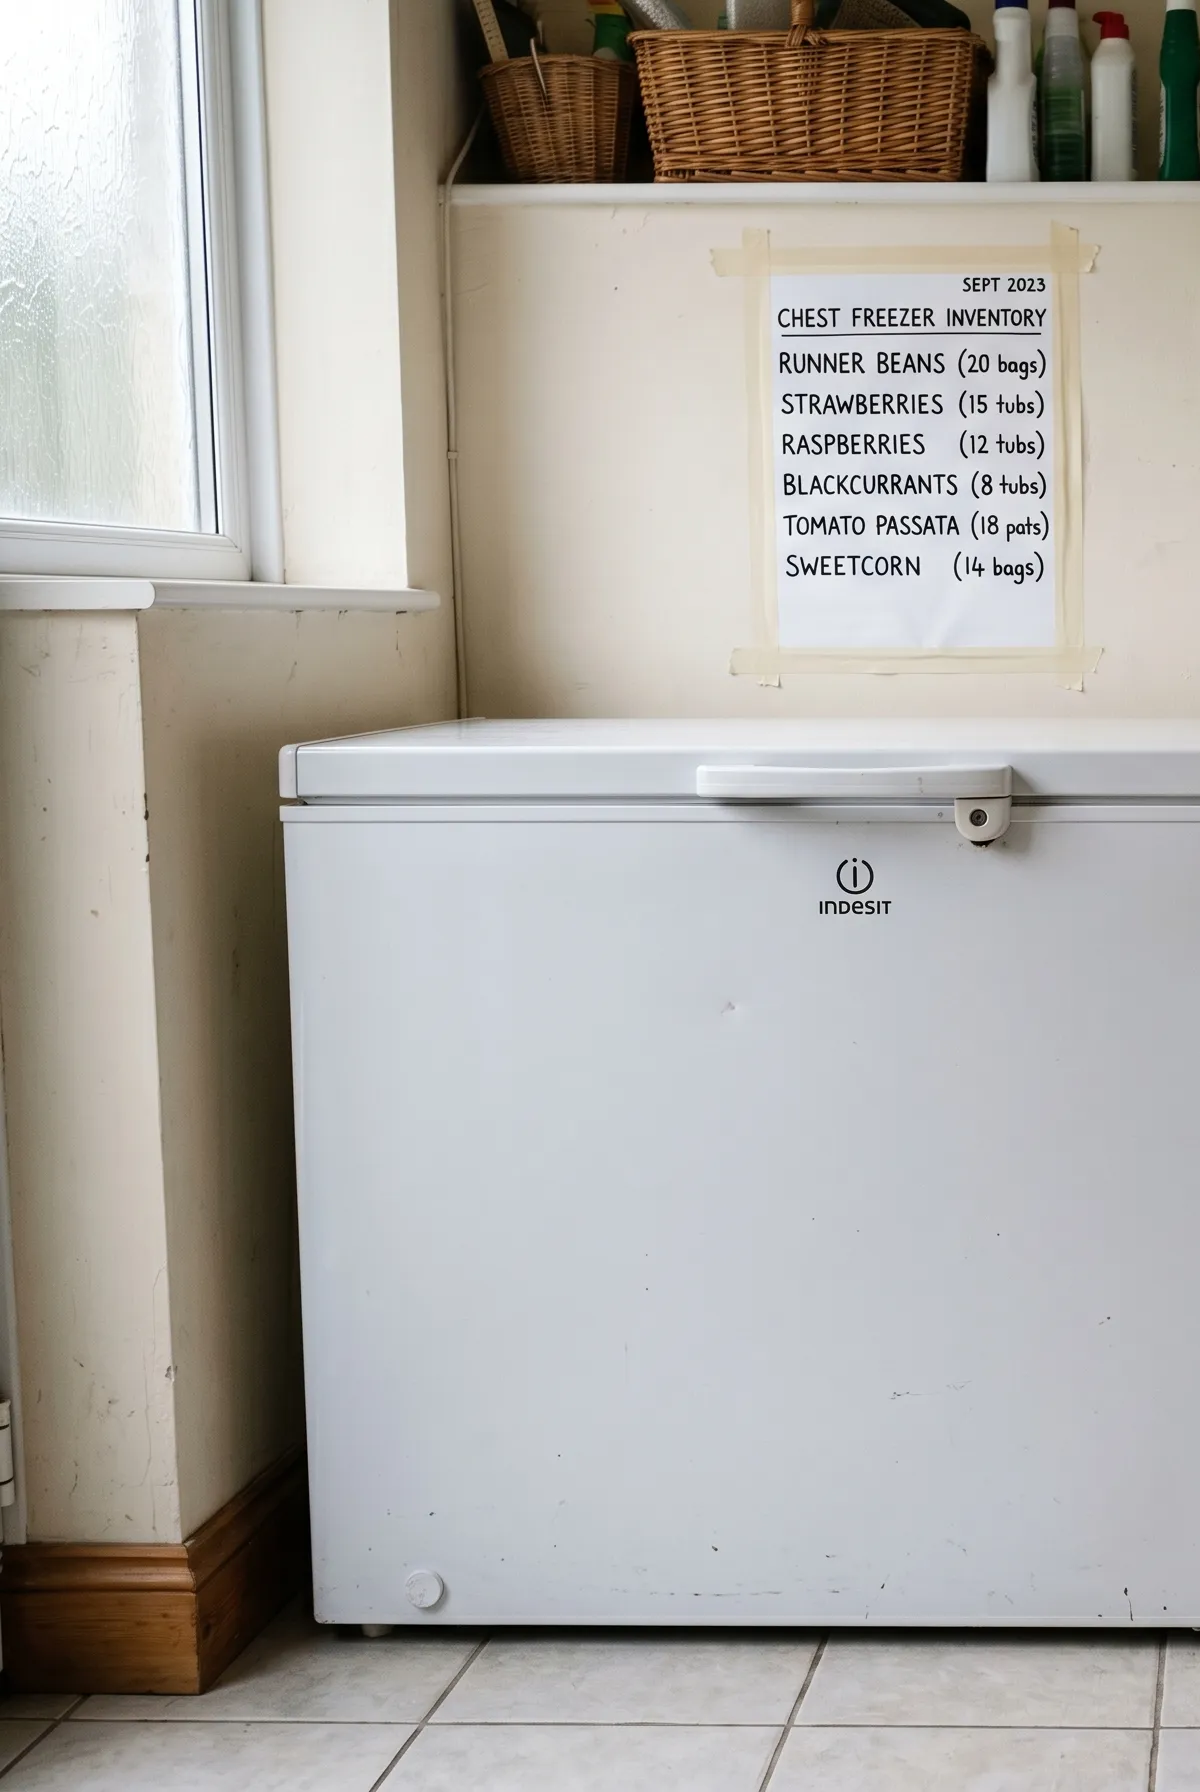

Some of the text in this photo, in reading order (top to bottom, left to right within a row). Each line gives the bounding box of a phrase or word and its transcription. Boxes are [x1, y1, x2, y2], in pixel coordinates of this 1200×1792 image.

[963, 278, 1045, 292] SEPT 2023
[778, 308, 1046, 327] CHEST FREEZER INVENTORY
[780, 349, 1046, 380] RUNNER BEANS (20 bags)
[782, 390, 1044, 418] STRAWBERRIES (15 tubs)
[783, 430, 1044, 459] RASPBERRIES (12 tubs)
[784, 471, 1046, 499] BLACKCURRANTS (8 tubs)
[783, 515, 865, 535] TOMATO
[877, 515, 959, 535] PASSATA
[971, 511, 998, 540] (18
[786, 552, 1043, 584] SWEETCORN (14 bags)
